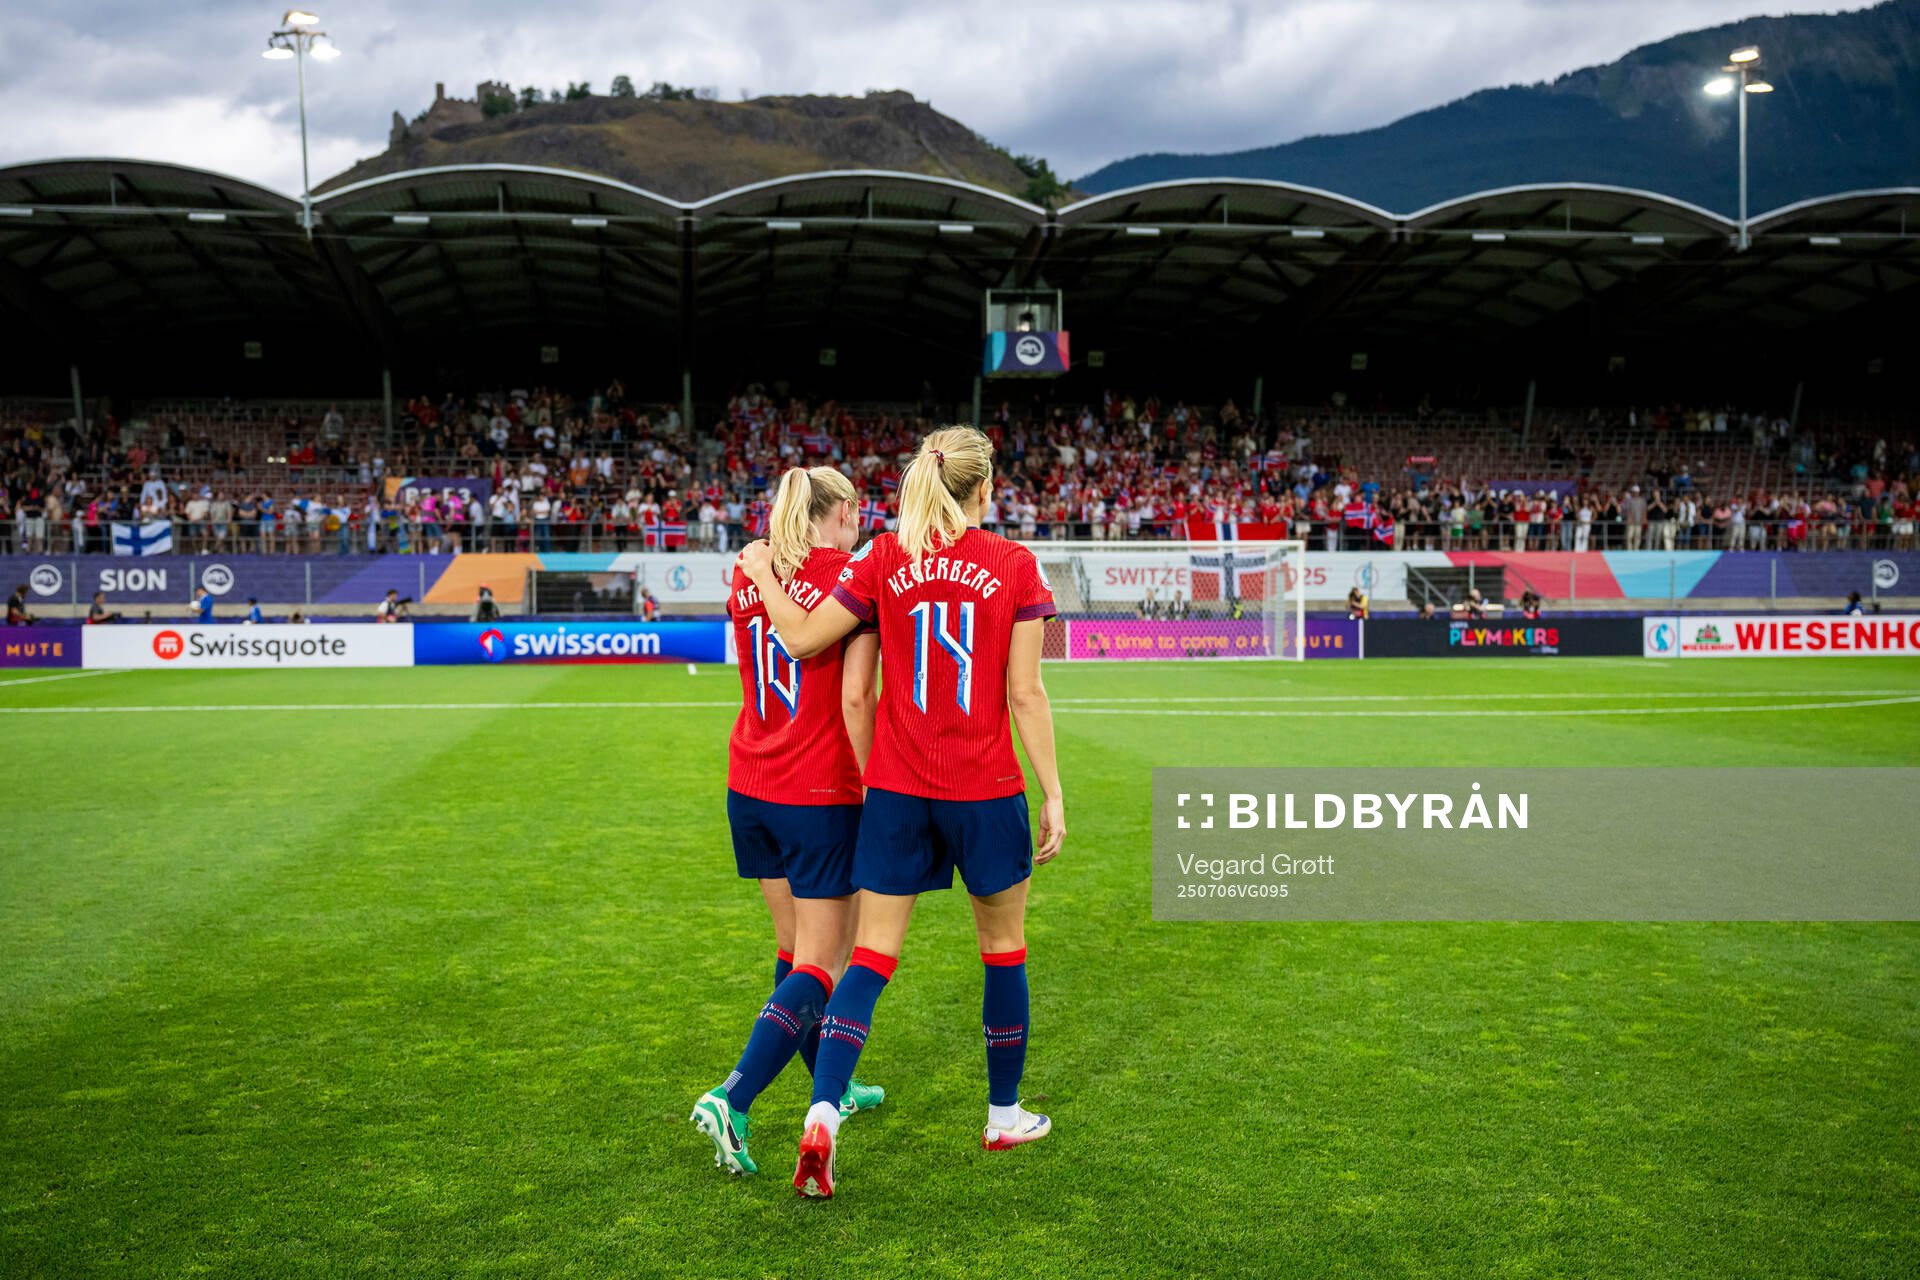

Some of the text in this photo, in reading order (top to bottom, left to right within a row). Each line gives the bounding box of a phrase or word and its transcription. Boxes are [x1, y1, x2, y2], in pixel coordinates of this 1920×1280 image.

[99, 568, 167, 591] SION
[1104, 567, 1187, 586] SWITZE
[513, 626, 661, 656] swisscom
[1115, 633, 1154, 649] time
[1157, 635, 1177, 649] to
[1180, 635, 1230, 649] come
[1450, 627, 1559, 646] PLAYMAKERS
[6, 642, 63, 657] MUTE
[189, 633, 347, 662] Swissquote
[907, 601, 975, 717] 14
